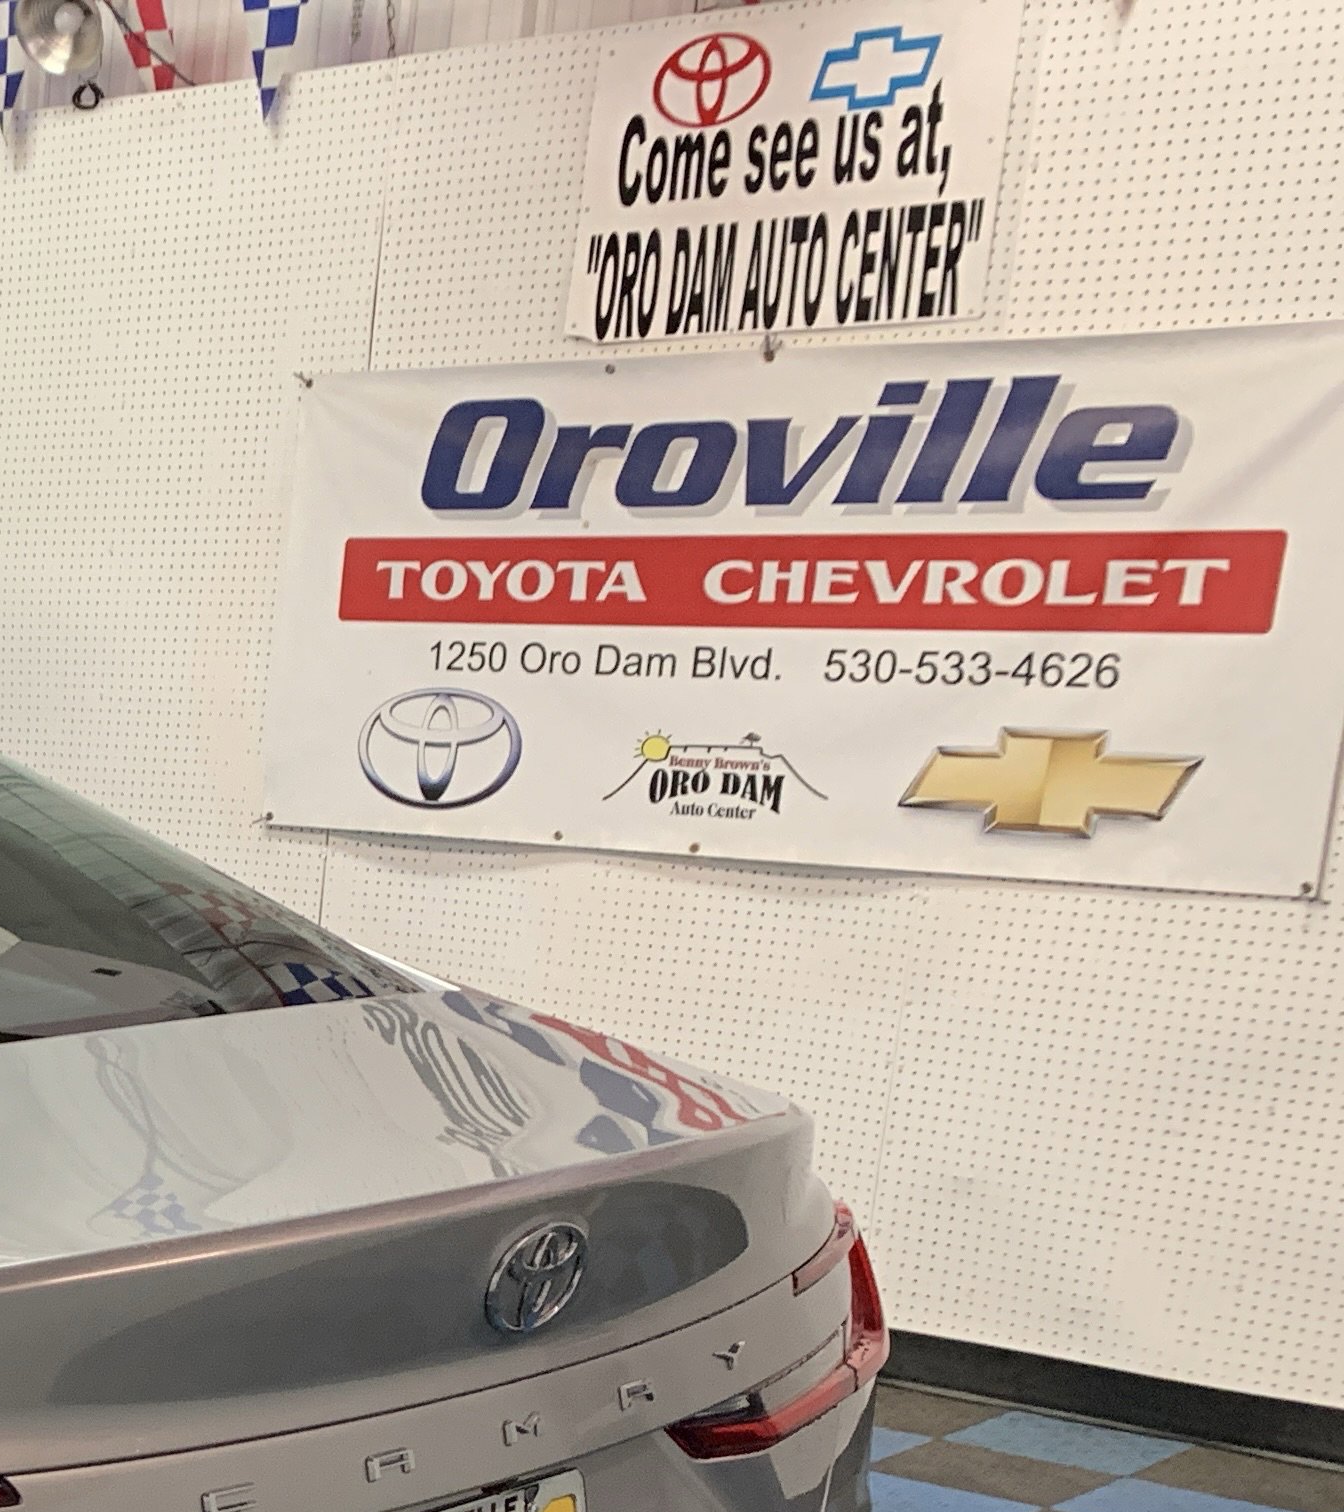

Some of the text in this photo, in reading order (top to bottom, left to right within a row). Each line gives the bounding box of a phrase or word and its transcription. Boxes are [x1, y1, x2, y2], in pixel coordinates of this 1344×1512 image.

[618, 77, 952, 207] Come see us at,
[587, 197, 985, 341] "ORO DAM AUTO CENTER"
[421, 374, 1182, 514] Oroville
[376, 556, 1231, 607] TOYOTA CHEVROLET
[428, 641, 1119, 690] 1250 Oro Dam Blvd. 530-533-4626
[669, 755, 771, 772] Benny Brown's
[648, 768, 786, 814] ORO DAM
[670, 801, 757, 820] Auto Center
